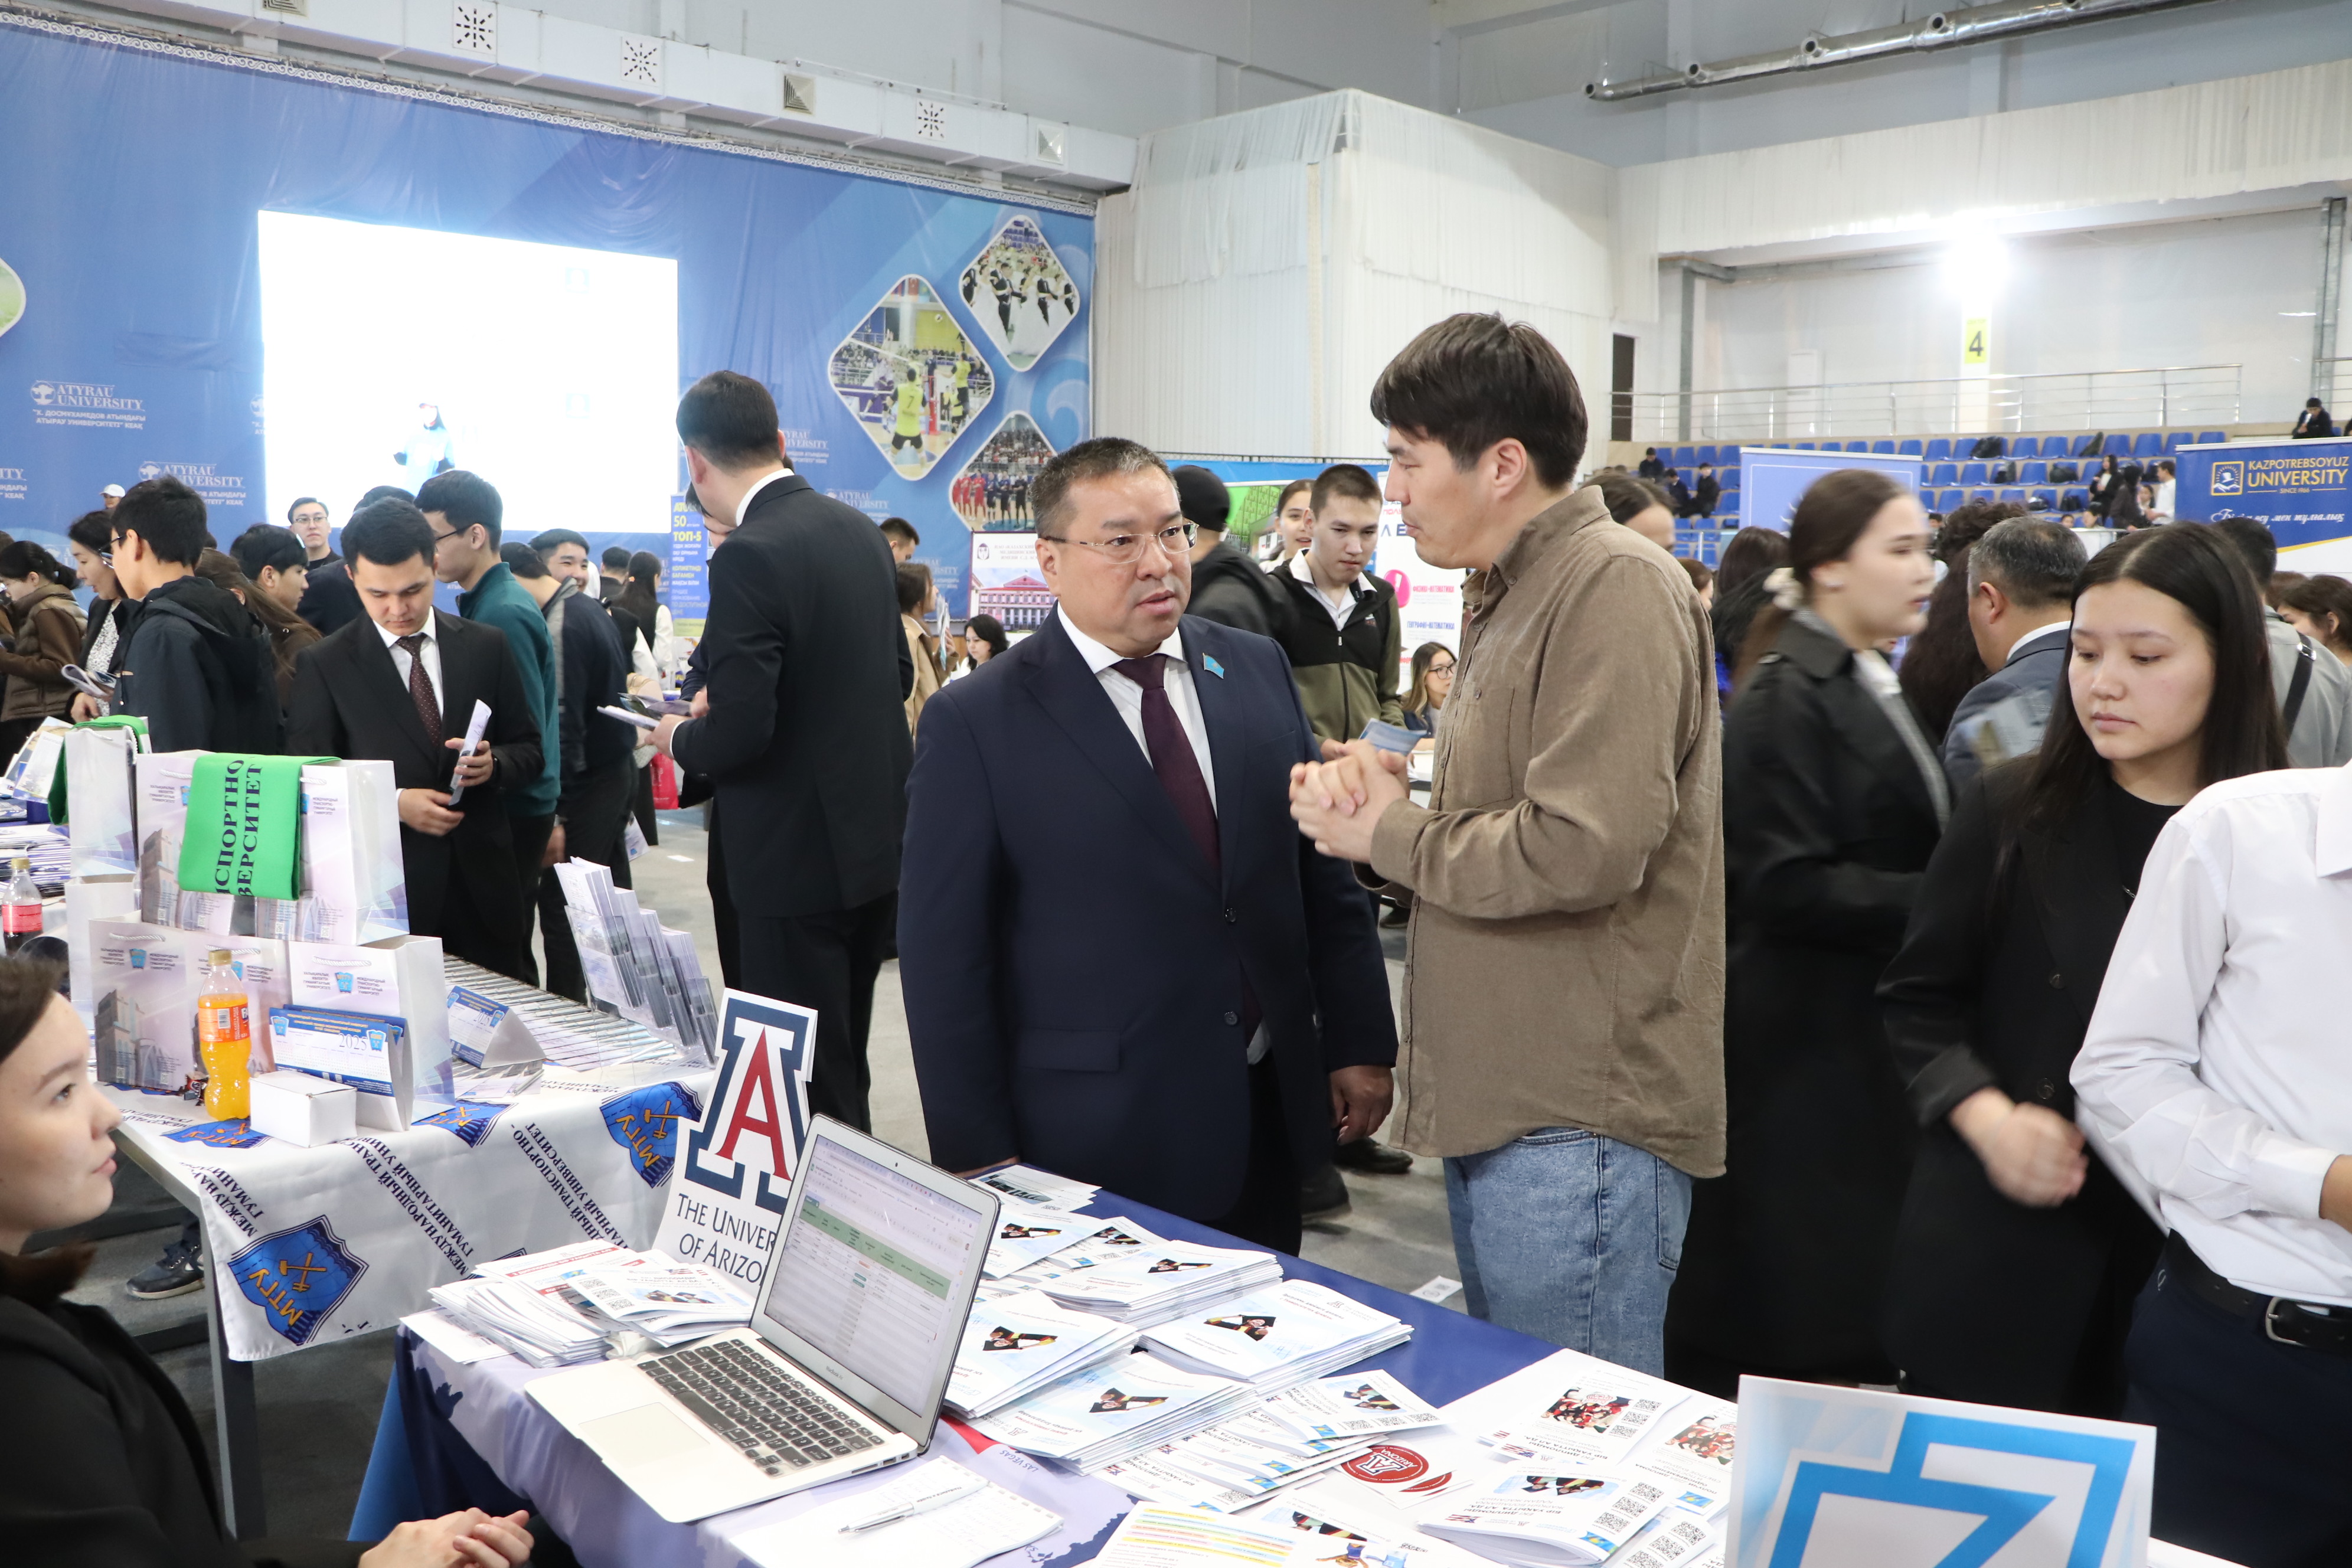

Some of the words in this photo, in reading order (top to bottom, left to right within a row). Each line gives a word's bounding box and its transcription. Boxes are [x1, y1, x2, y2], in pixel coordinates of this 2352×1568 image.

[1969, 331, 1984, 357] 4
[58, 384, 114, 397] ATYRAU
[58, 394, 143, 409] UNIVERSITY
[783, 430, 810, 439] YRAU
[786, 439, 828, 449] IVERSITY
[163, 464, 215, 476] ATYRAU
[2249, 456, 2350, 470] KAZPOTREBSOYUZ
[179, 475, 243, 486] IVERSITY
[2248, 469, 2348, 487] UNIVERSITY
[674, 515, 687, 527] 50
[674, 531, 702, 541] ТОП-5
[338, 1033, 367, 1051] 2025
[615, 1114, 661, 1168] МТГУ
[525, 1122, 588, 1201] УНИВЕРСИТЕТ
[392, 1162, 473, 1257] ГУМАНИТАРНЫЙ
[677, 1193, 708, 1226] THE
[378, 1171, 469, 1275] МЕЖДУНАРОДНЫЙ
[680, 1233, 704, 1258] OF
[249, 1268, 304, 1327] МТГУ
[999, 1450, 1025, 1466] VEGAS
[1381, 1449, 1418, 1468] ARIZONA
[1022, 1463, 1039, 1472] LAS
